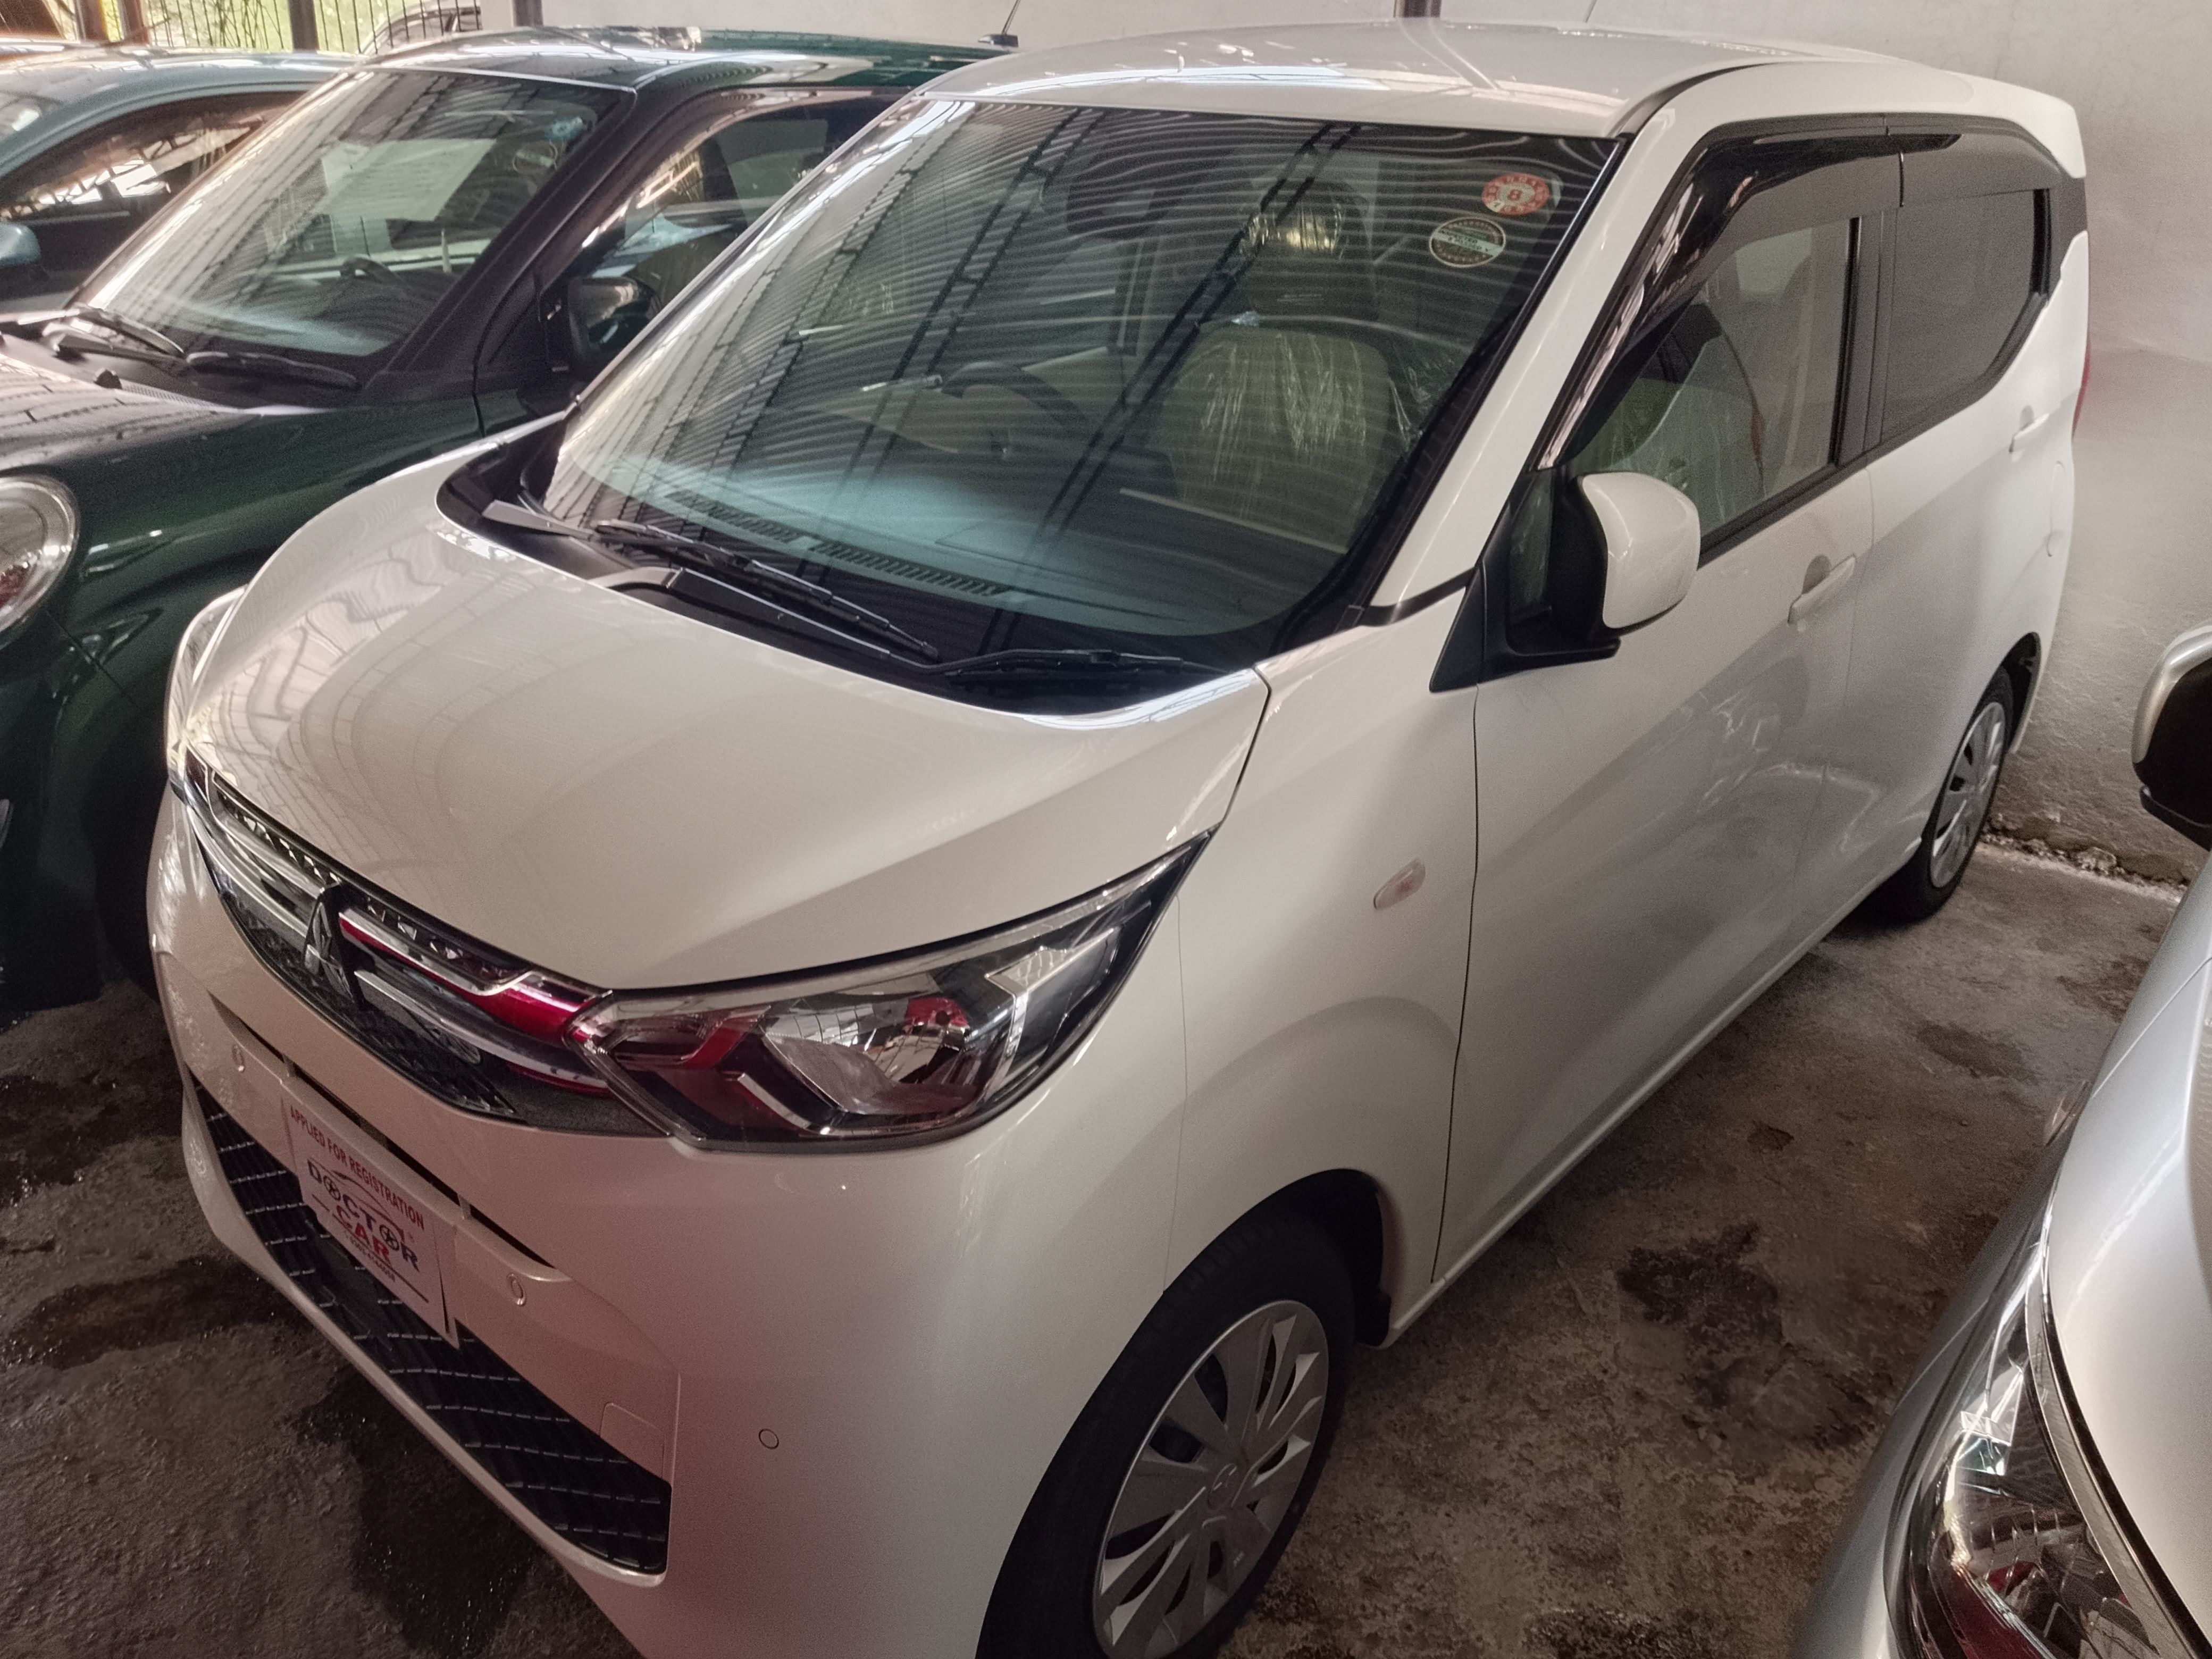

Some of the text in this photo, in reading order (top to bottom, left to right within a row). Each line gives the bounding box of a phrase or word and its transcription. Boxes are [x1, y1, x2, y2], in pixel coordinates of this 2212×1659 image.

[291, 1106, 425, 1230] APPLIED FOR REGISTRATION
[308, 1161, 420, 1271] DOCTOR
[337, 1205, 390, 1264] CAR
